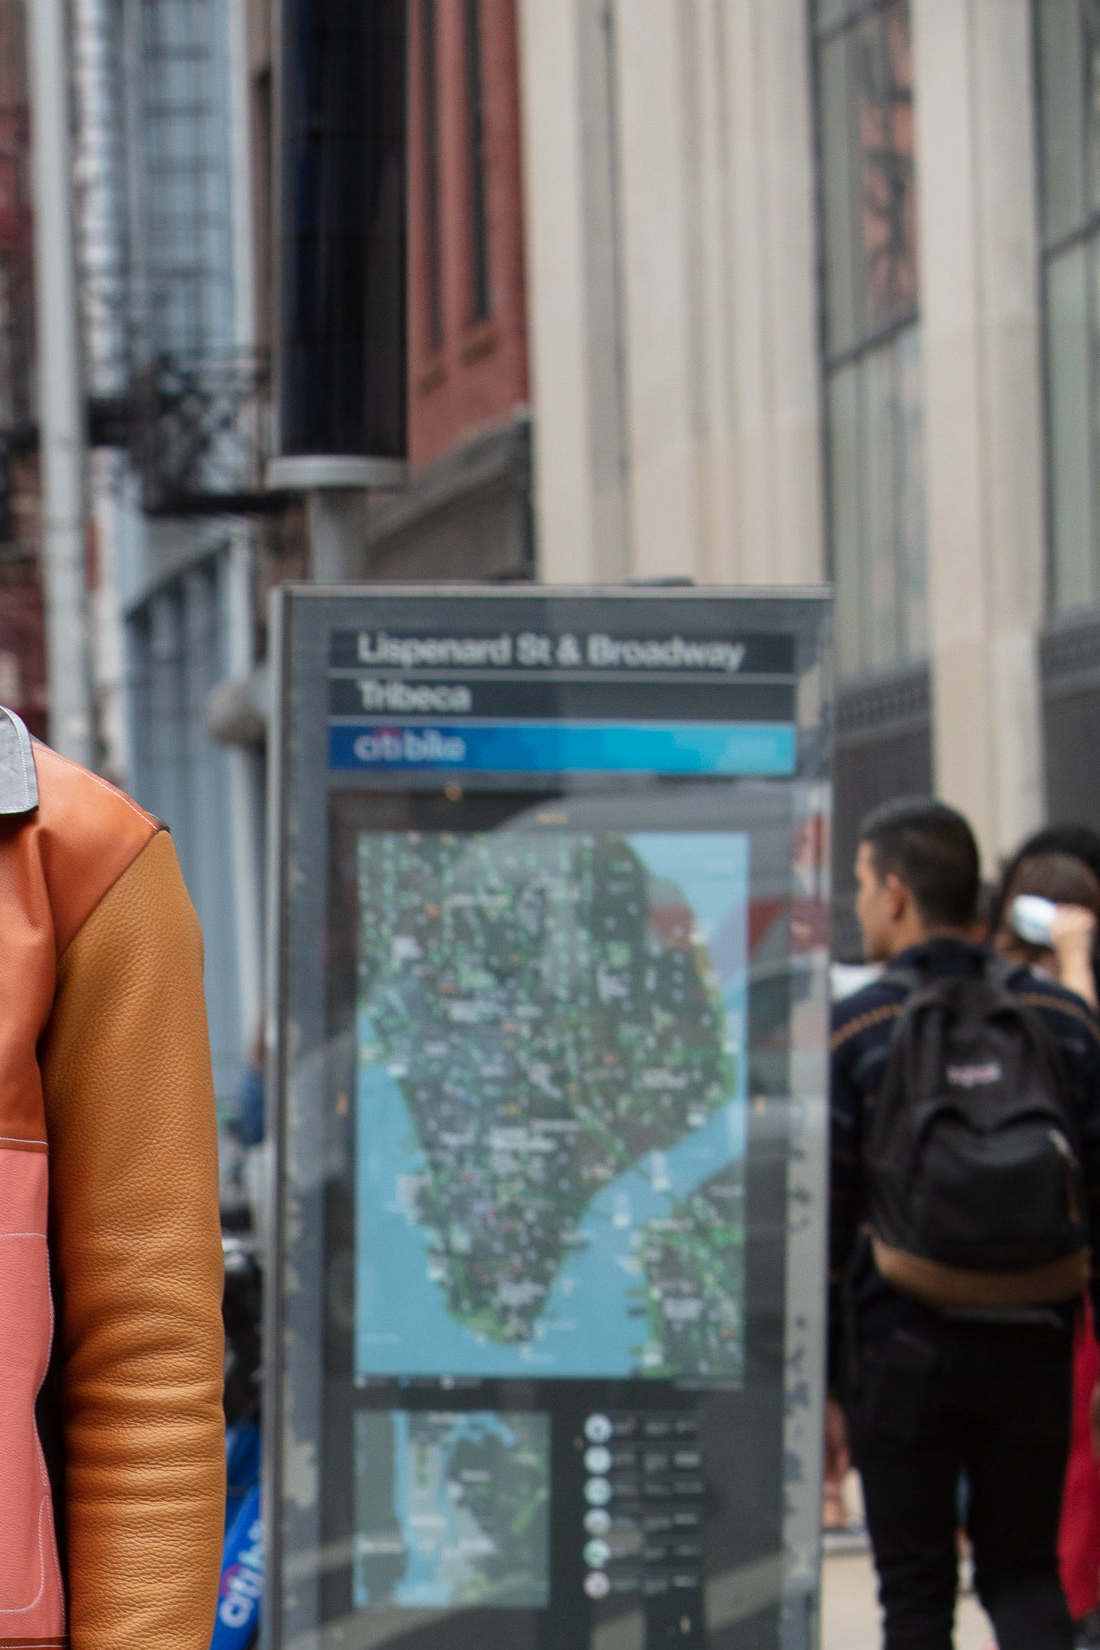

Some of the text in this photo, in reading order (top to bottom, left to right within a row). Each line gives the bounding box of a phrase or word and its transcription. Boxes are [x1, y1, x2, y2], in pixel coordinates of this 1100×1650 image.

[358, 632, 745, 672] Lispenard St & Broadway
[356, 679, 472, 712] Tribeca
